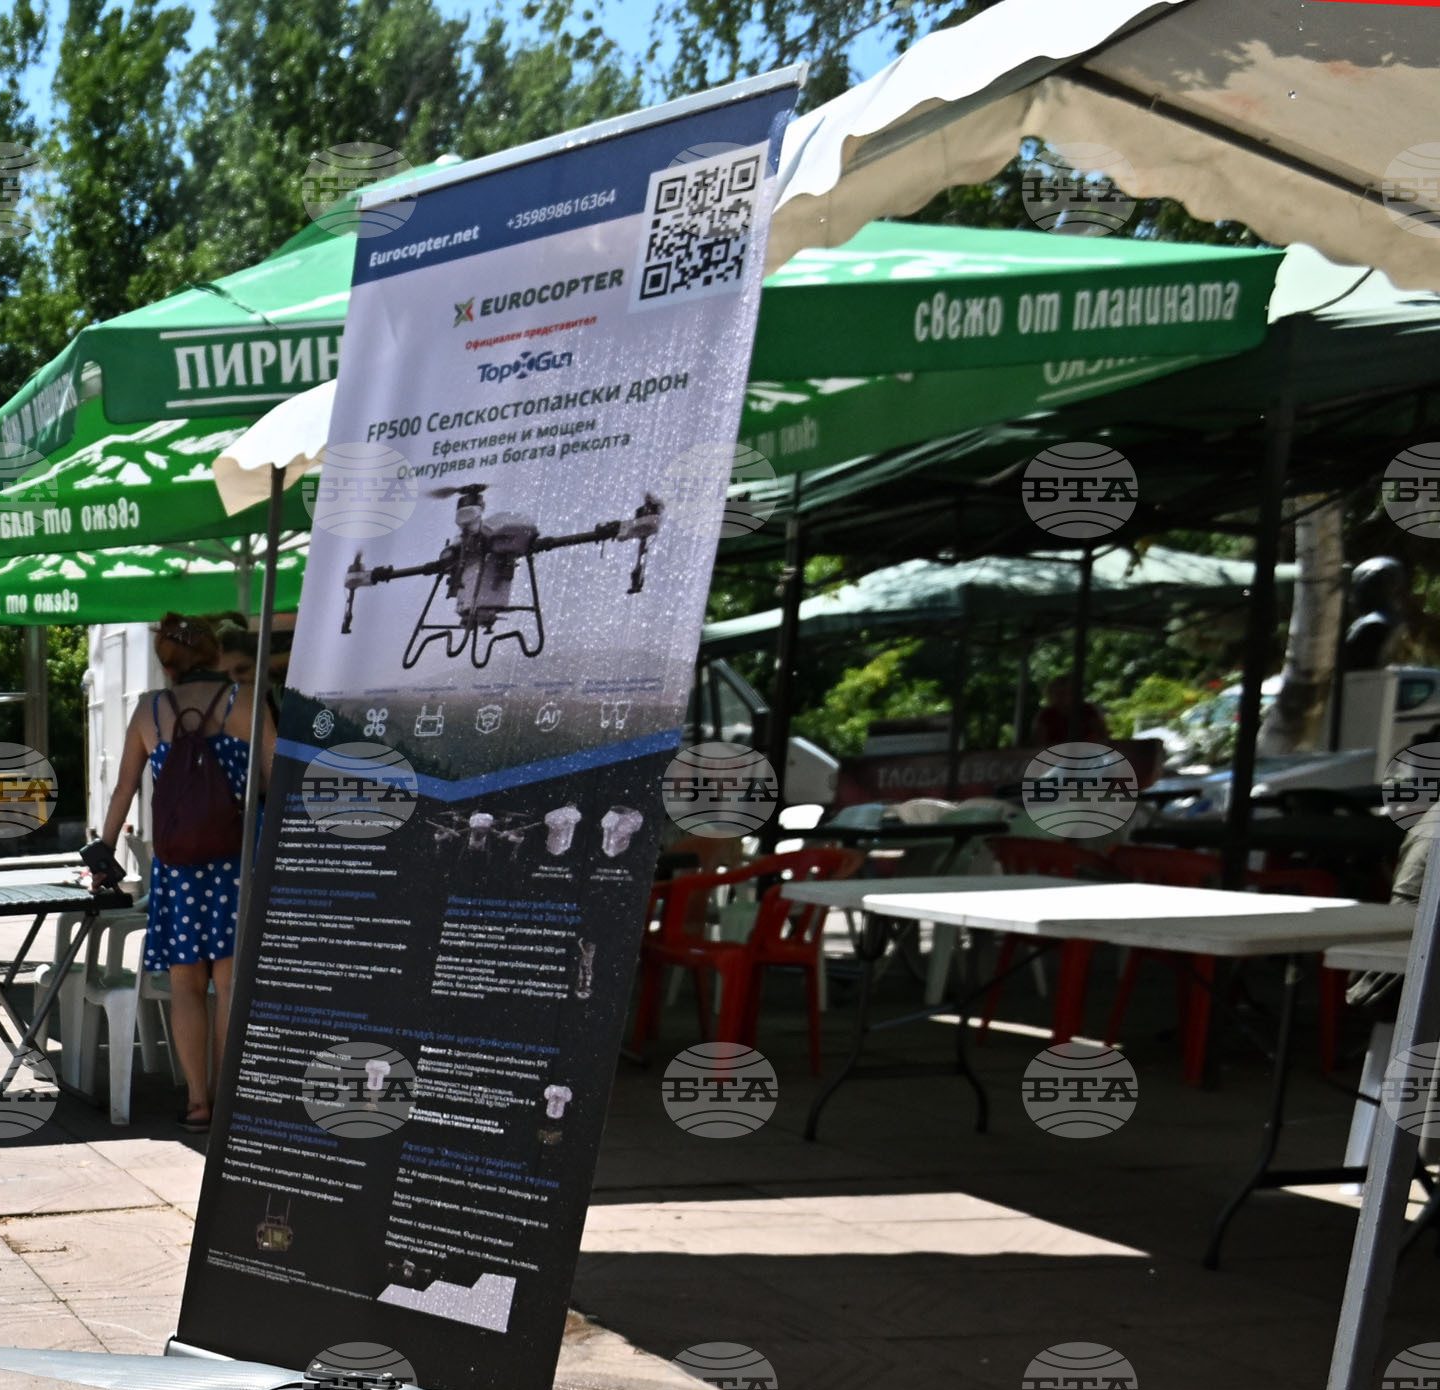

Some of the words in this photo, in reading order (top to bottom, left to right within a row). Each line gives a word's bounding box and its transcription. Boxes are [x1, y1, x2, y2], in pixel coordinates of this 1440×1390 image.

[369, 226, 480, 268] Eurocopter.net
[506, 189, 617, 230] +359898616364
[479, 269, 624, 317] EUROCOPTER
[914, 291, 1001, 342] свежо
[1017, 295, 1060, 334] от
[1072, 281, 1240, 331] планината
[465, 329, 522, 351] Официален
[523, 315, 597, 339] представител
[174, 336, 344, 391] ПИРИН
[366, 415, 421, 444] FP500
[427, 384, 621, 433] Селскостопански
[625, 371, 689, 404] дрон
[396, 457, 475, 481] Осигурява
[479, 452, 498, 467] на
[502, 443, 557, 463] богата
[560, 433, 631, 458] реколта
[432, 430, 517, 457] Ефективен
[521, 430, 533, 443] и
[537, 417, 596, 440] мощен
